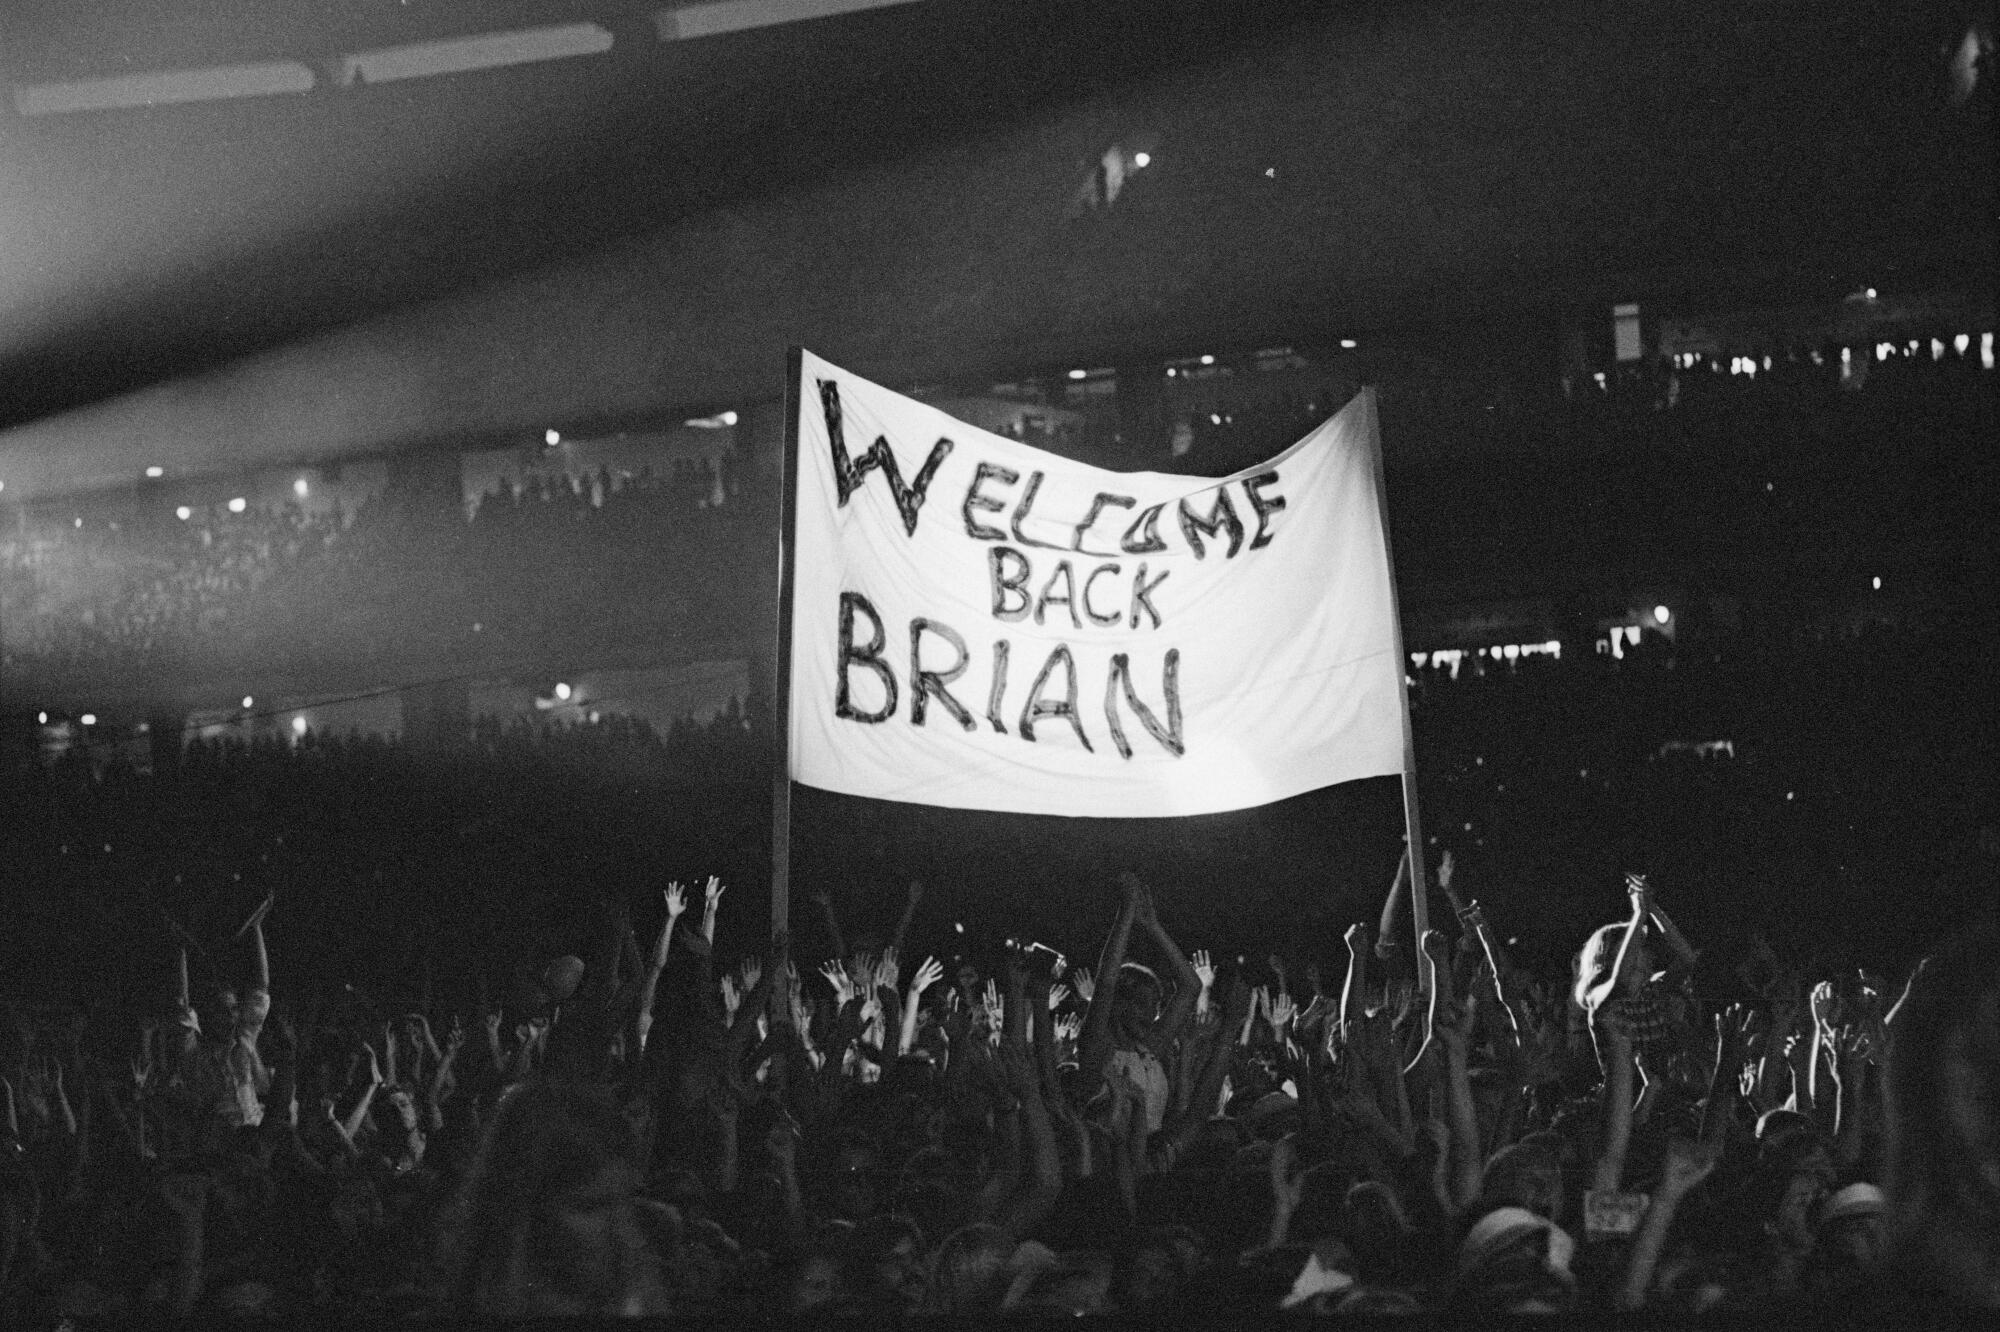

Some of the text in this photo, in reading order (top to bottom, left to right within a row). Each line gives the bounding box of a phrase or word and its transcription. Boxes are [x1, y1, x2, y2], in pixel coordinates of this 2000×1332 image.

[816, 378, 1287, 560] WELCOME
[988, 546, 1171, 630] BACK
[835, 591, 1185, 760] BRIAN
